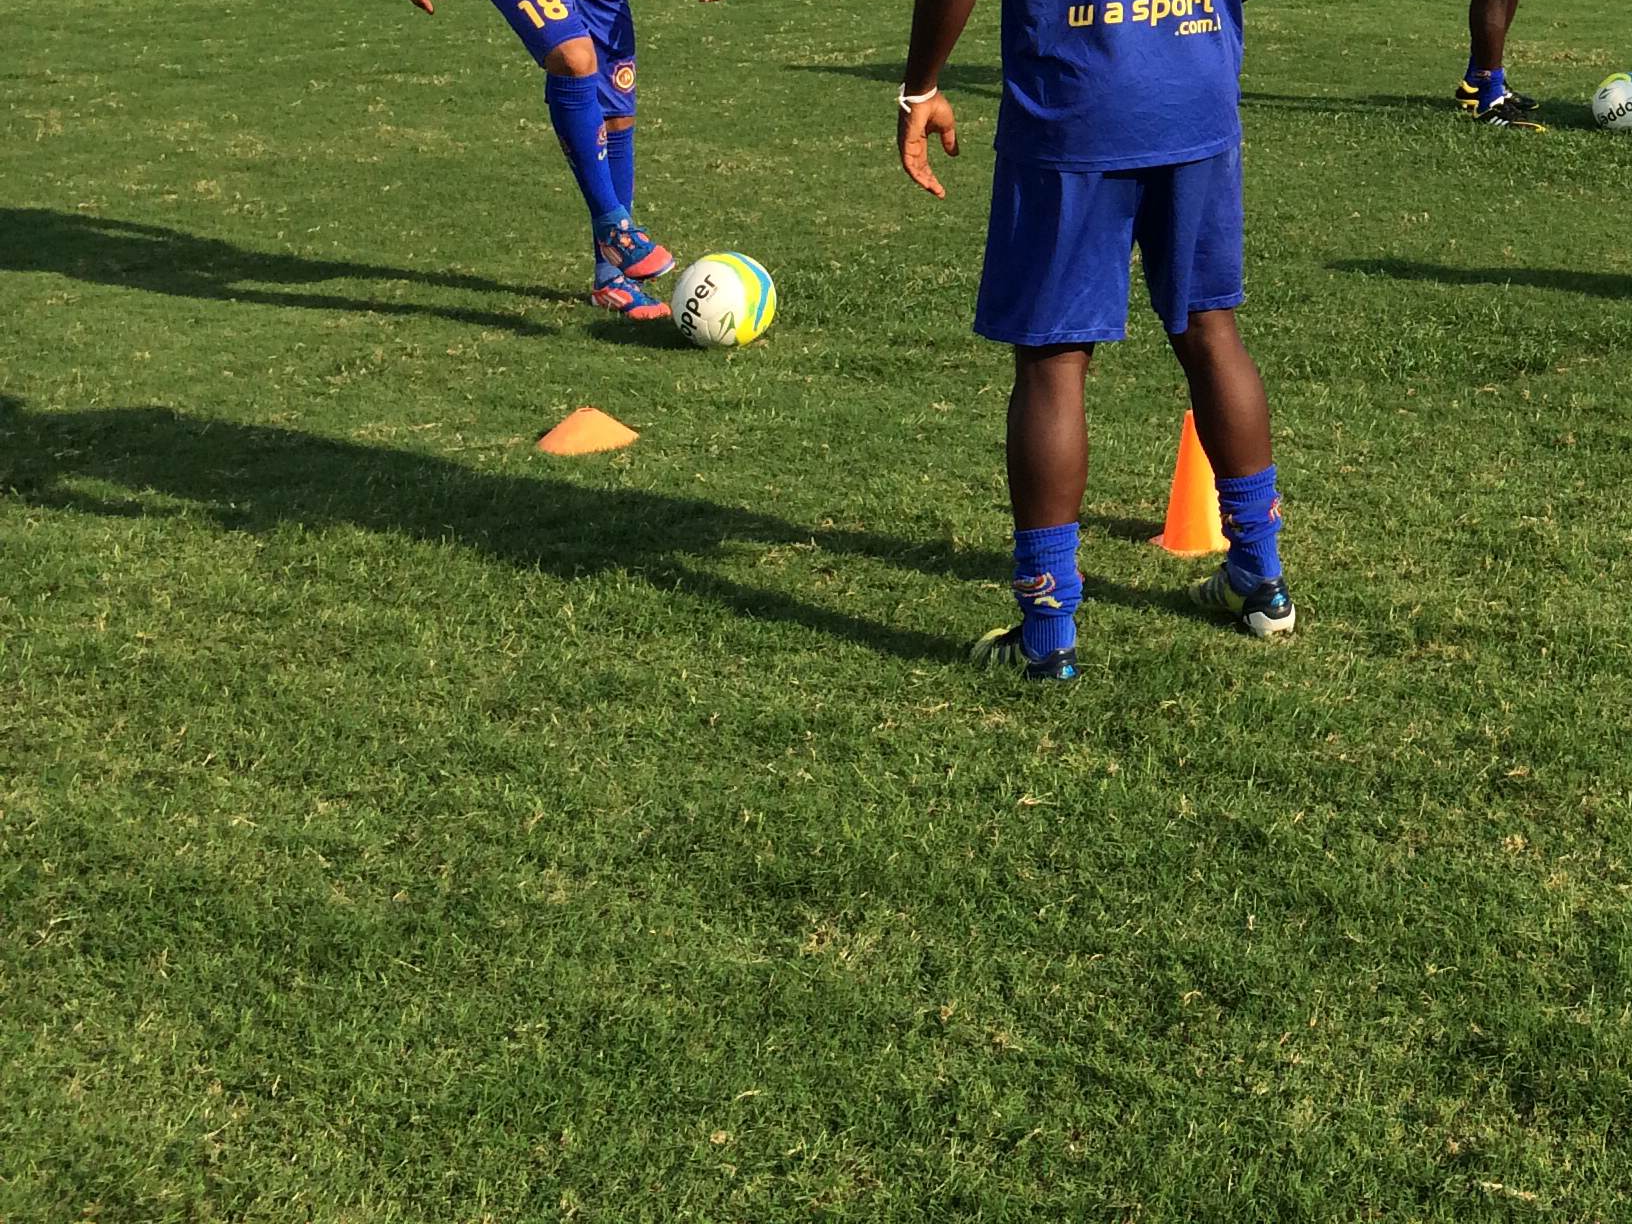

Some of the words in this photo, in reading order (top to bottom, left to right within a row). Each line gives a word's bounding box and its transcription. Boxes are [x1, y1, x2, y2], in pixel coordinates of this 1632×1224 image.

[1067, 4, 1095, 27] w
[1103, 1, 1125, 25] a
[680, 273, 716, 337] opper
